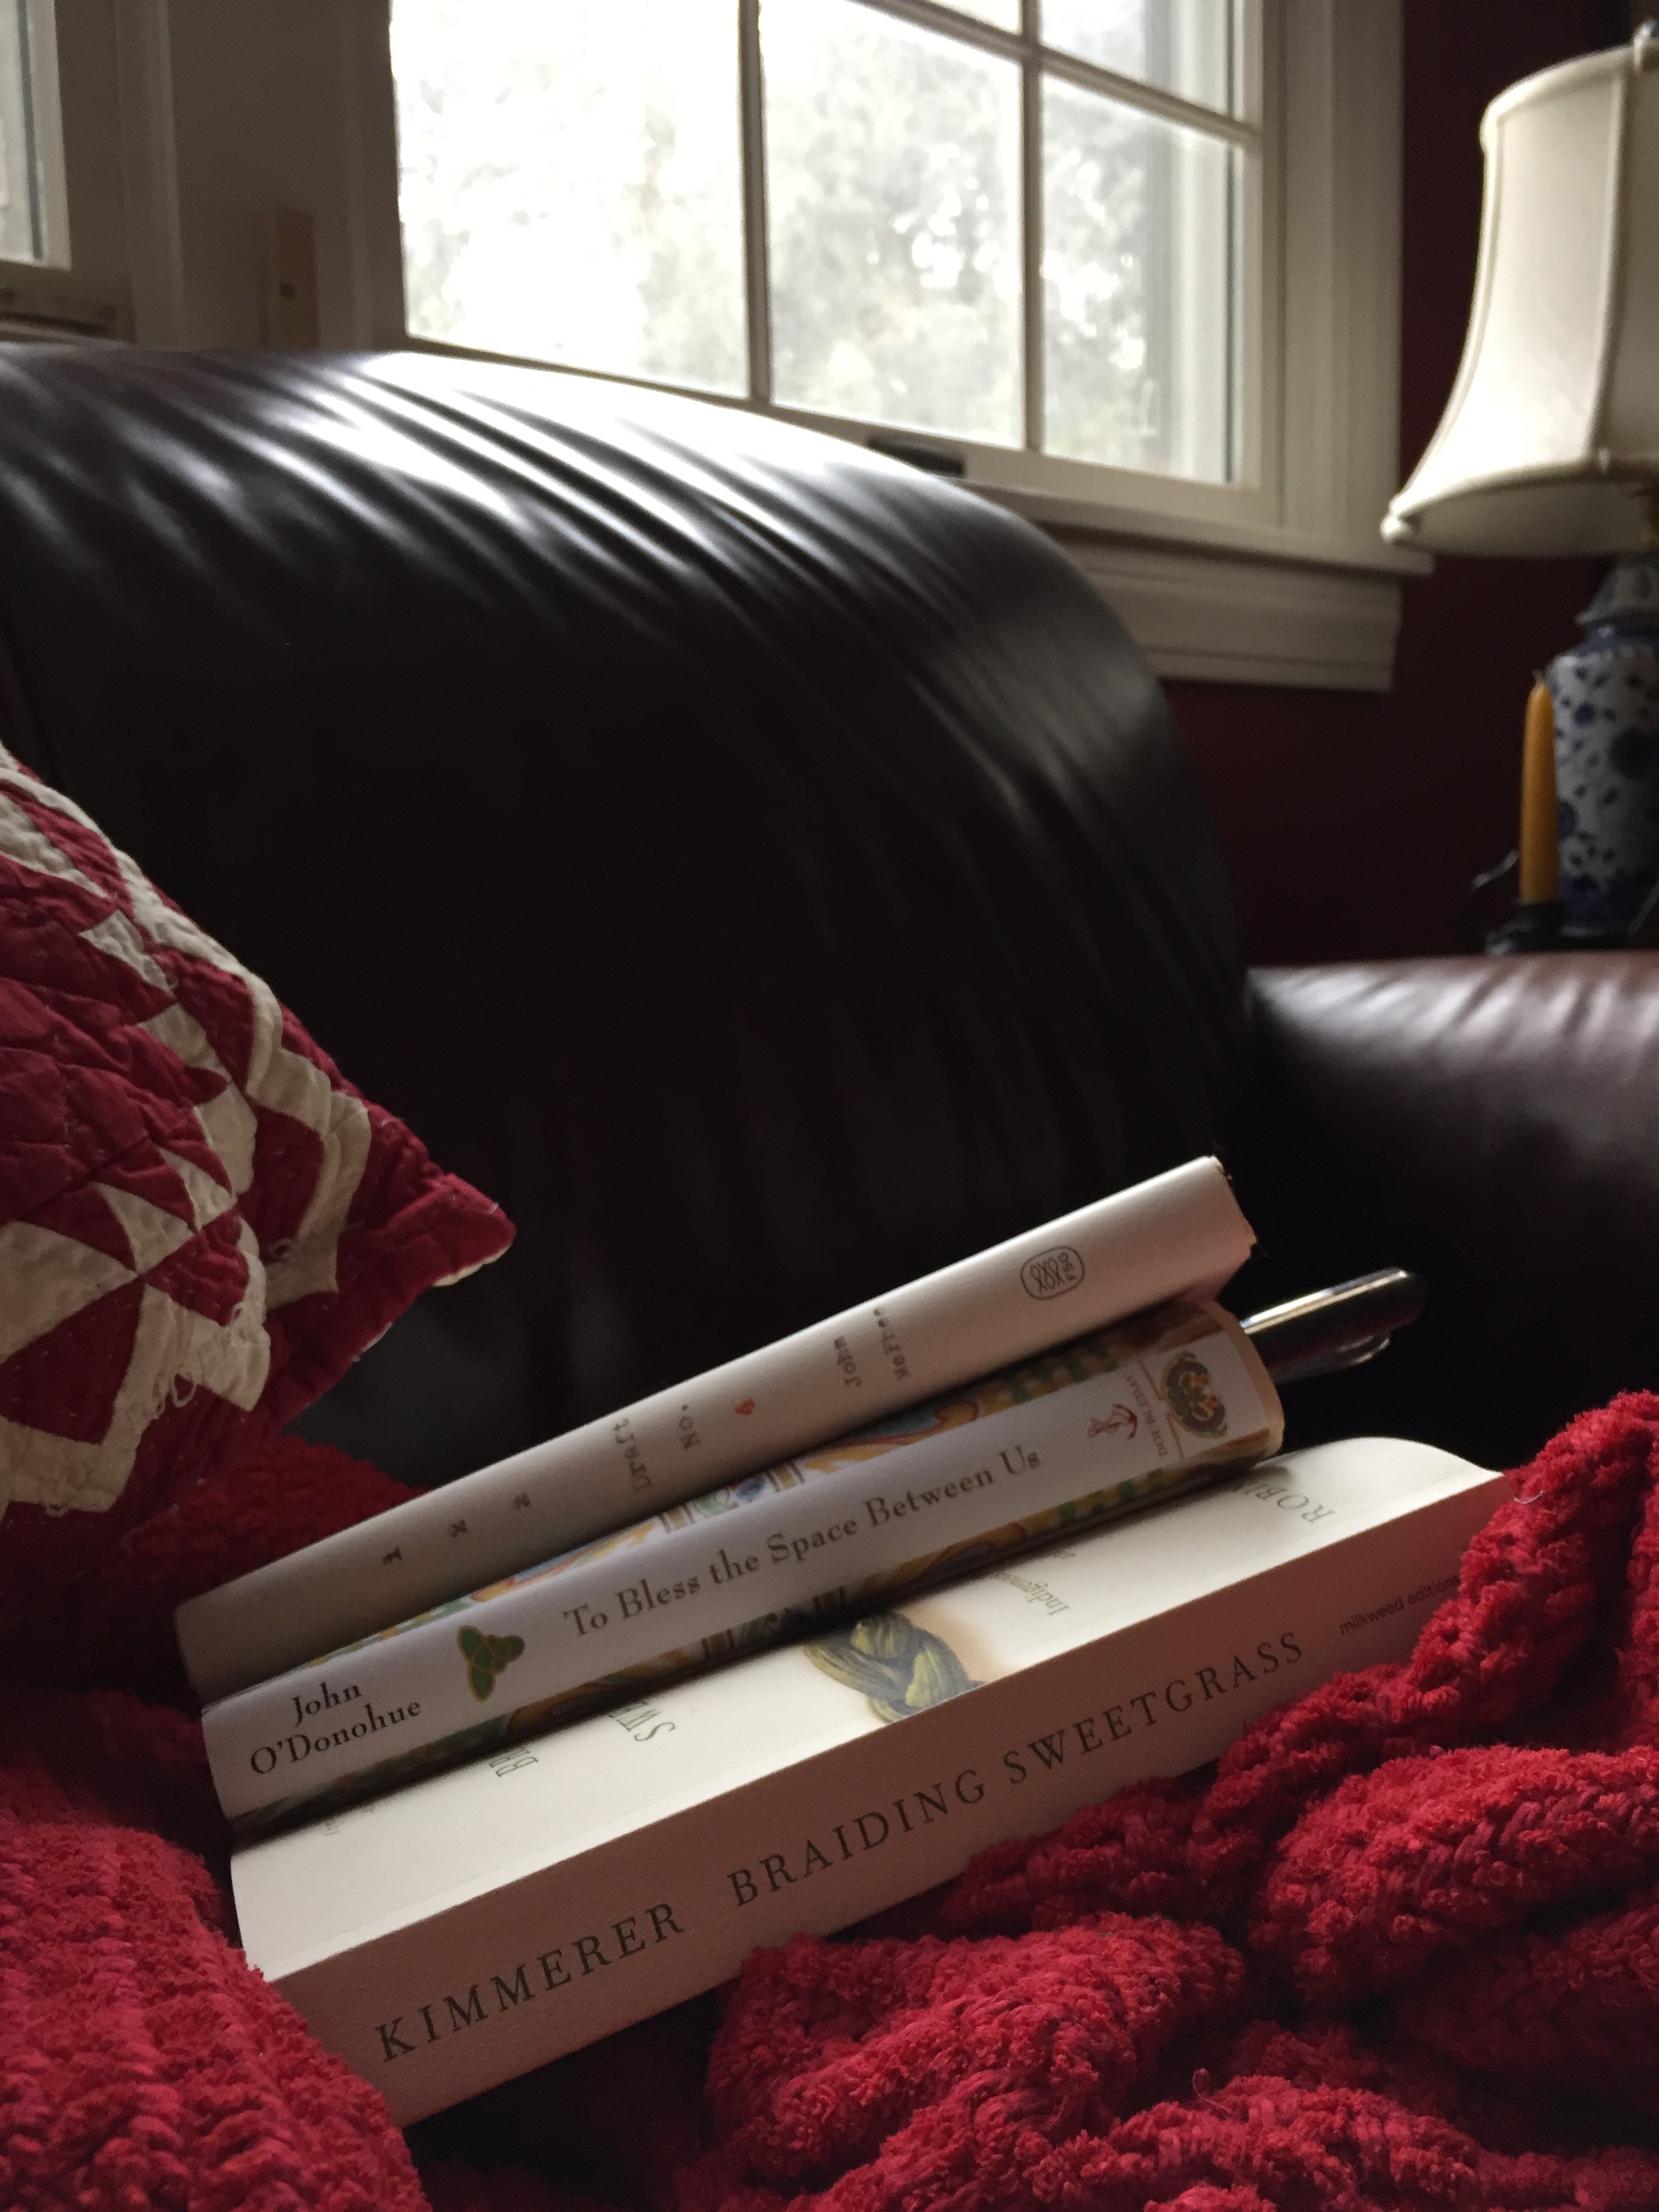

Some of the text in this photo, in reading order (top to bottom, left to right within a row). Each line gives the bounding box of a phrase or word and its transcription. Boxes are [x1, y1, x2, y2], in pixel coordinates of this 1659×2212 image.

[562, 1444, 1041, 1636] To Bless the Space Between Us
[1339, 1597, 1405, 1635] milkweed
[250, 1701, 422, 1774] O'Donohue
[292, 1681, 363, 1727] John
[375, 1631, 1303, 2062] KIMMERER BRAIDING SWEETGRASS
